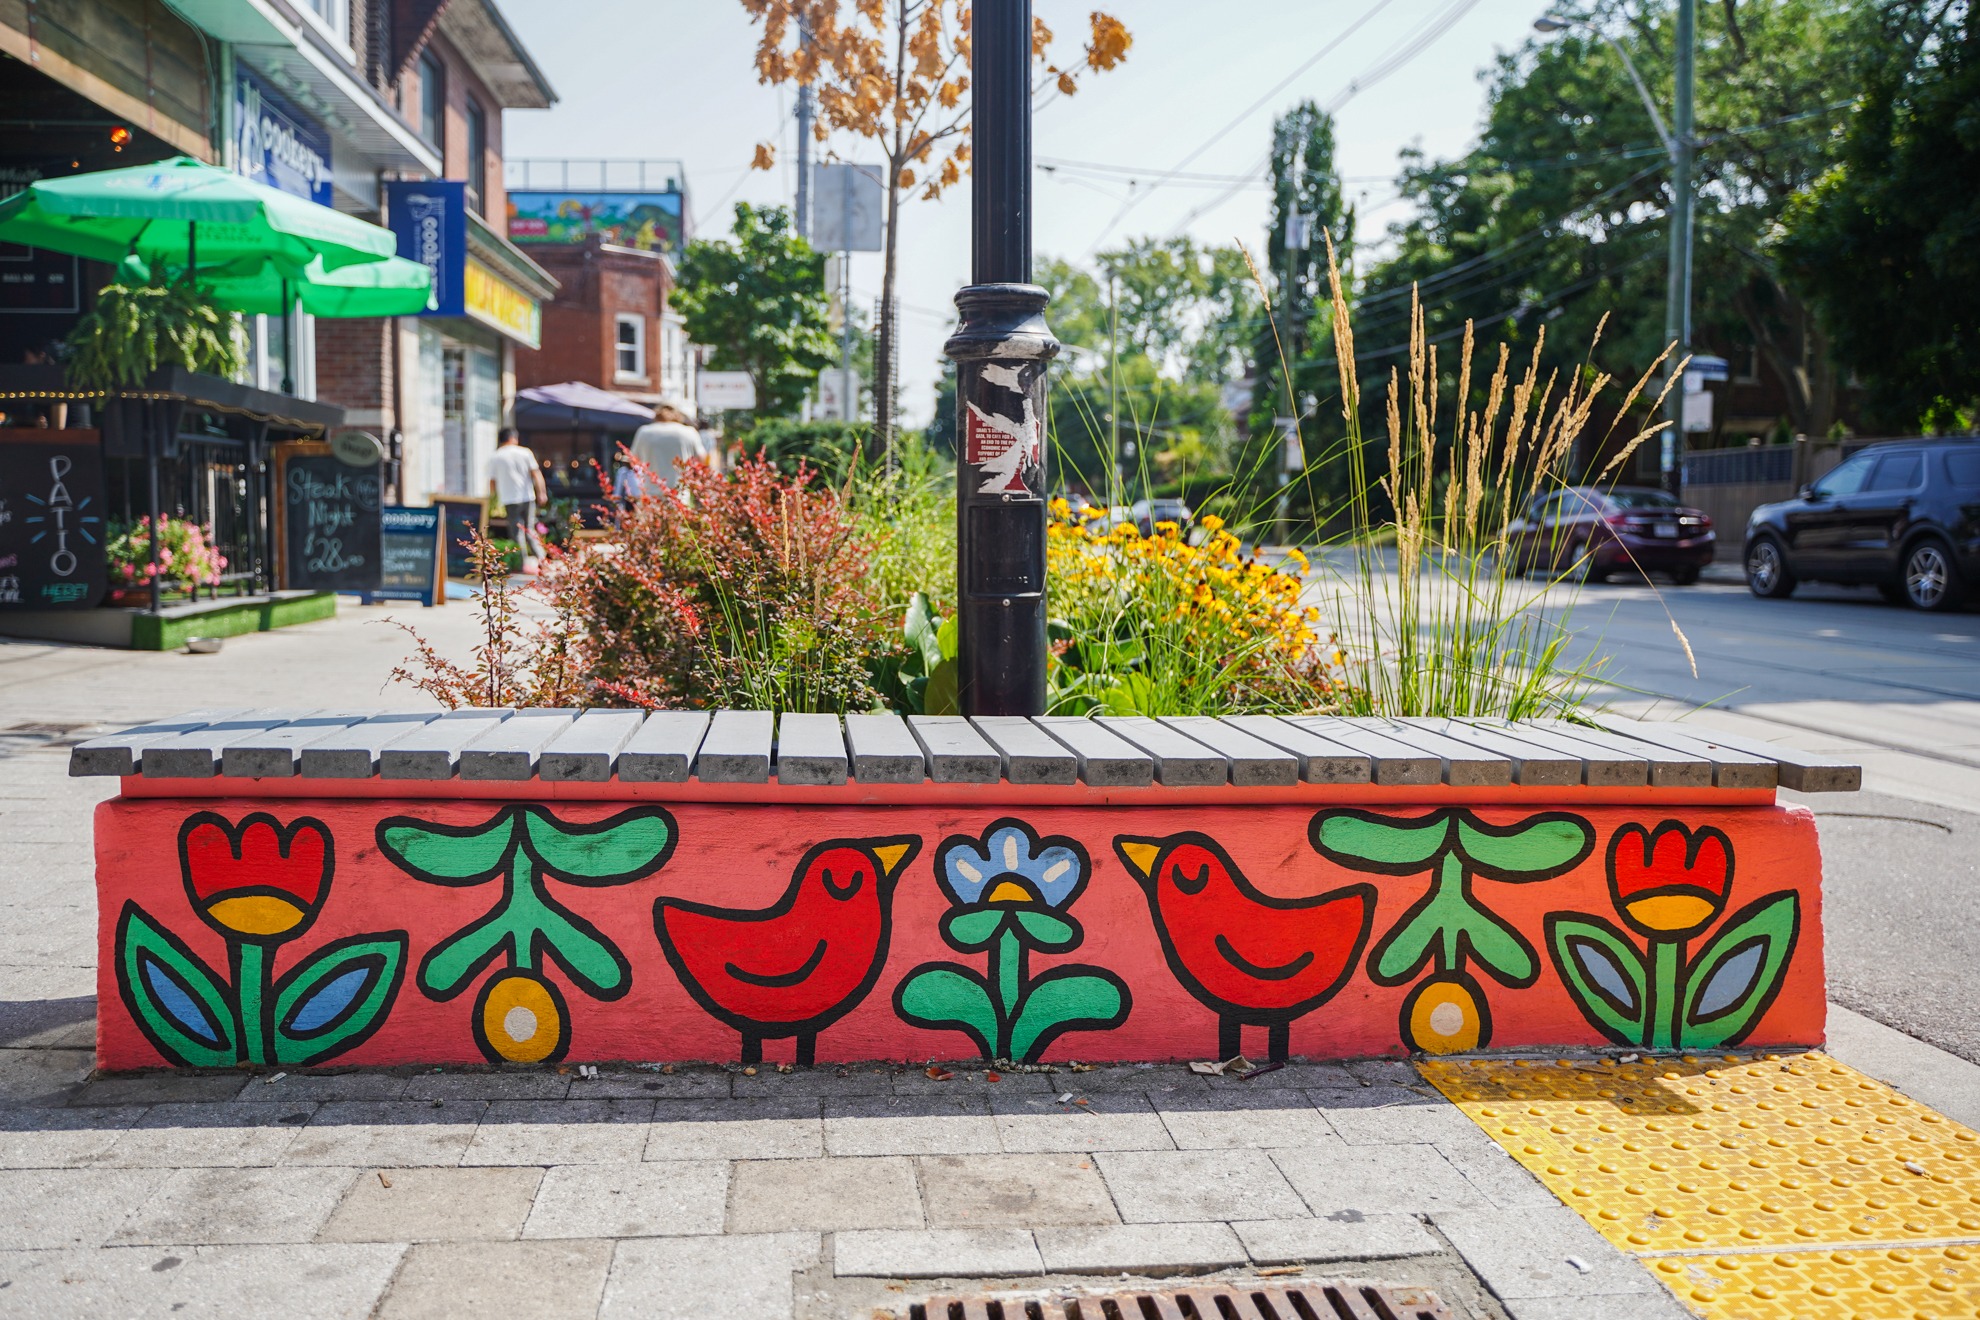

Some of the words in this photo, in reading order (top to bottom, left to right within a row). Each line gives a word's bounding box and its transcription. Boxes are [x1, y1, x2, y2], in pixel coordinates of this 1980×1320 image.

[260, 115, 324, 193] cookery
[288, 467, 355, 505] Steak
[49, 455, 77, 576] PATIO
[308, 500, 357, 536] Night
[41, 582, 89, 600] HERE!
